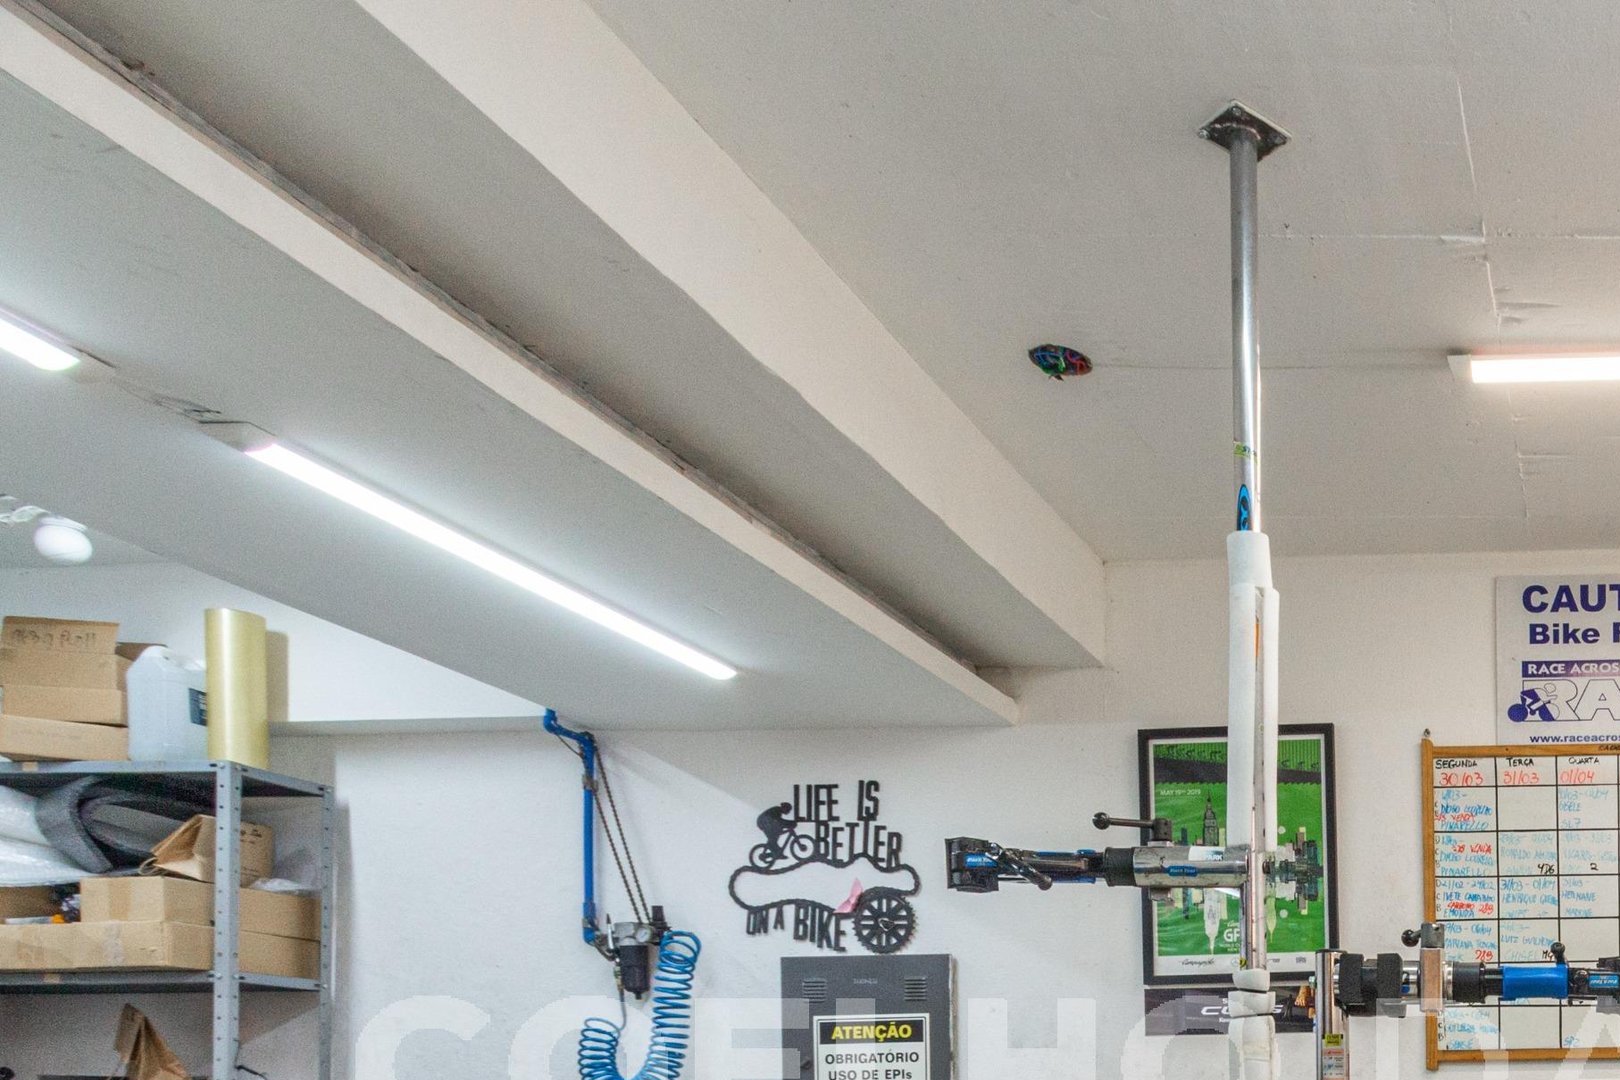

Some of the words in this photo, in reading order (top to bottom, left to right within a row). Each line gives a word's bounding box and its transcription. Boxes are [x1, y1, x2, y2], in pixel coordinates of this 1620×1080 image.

[1529, 623, 1600, 645] Bike
[1528, 662, 1566, 675] RACE
[1435, 759, 1478, 770] SEGUNDA
[1439, 772, 1484, 786] 30/03
[793, 783, 839, 822] LIFE
[858, 780, 880, 821] IS
[815, 819, 903, 868] BETTER
[1590, 862, 1599, 871] 2
[746, 907, 769, 936] ON
[773, 906, 785, 931] A
[793, 901, 848, 953] BIKE
[831, 1021, 912, 1043] ATENÇÃO
[824, 1048, 919, 1065] OBRIGATÓRIO
[861, 1068, 879, 1080] DE
[884, 1067, 912, 1080] EPIs
